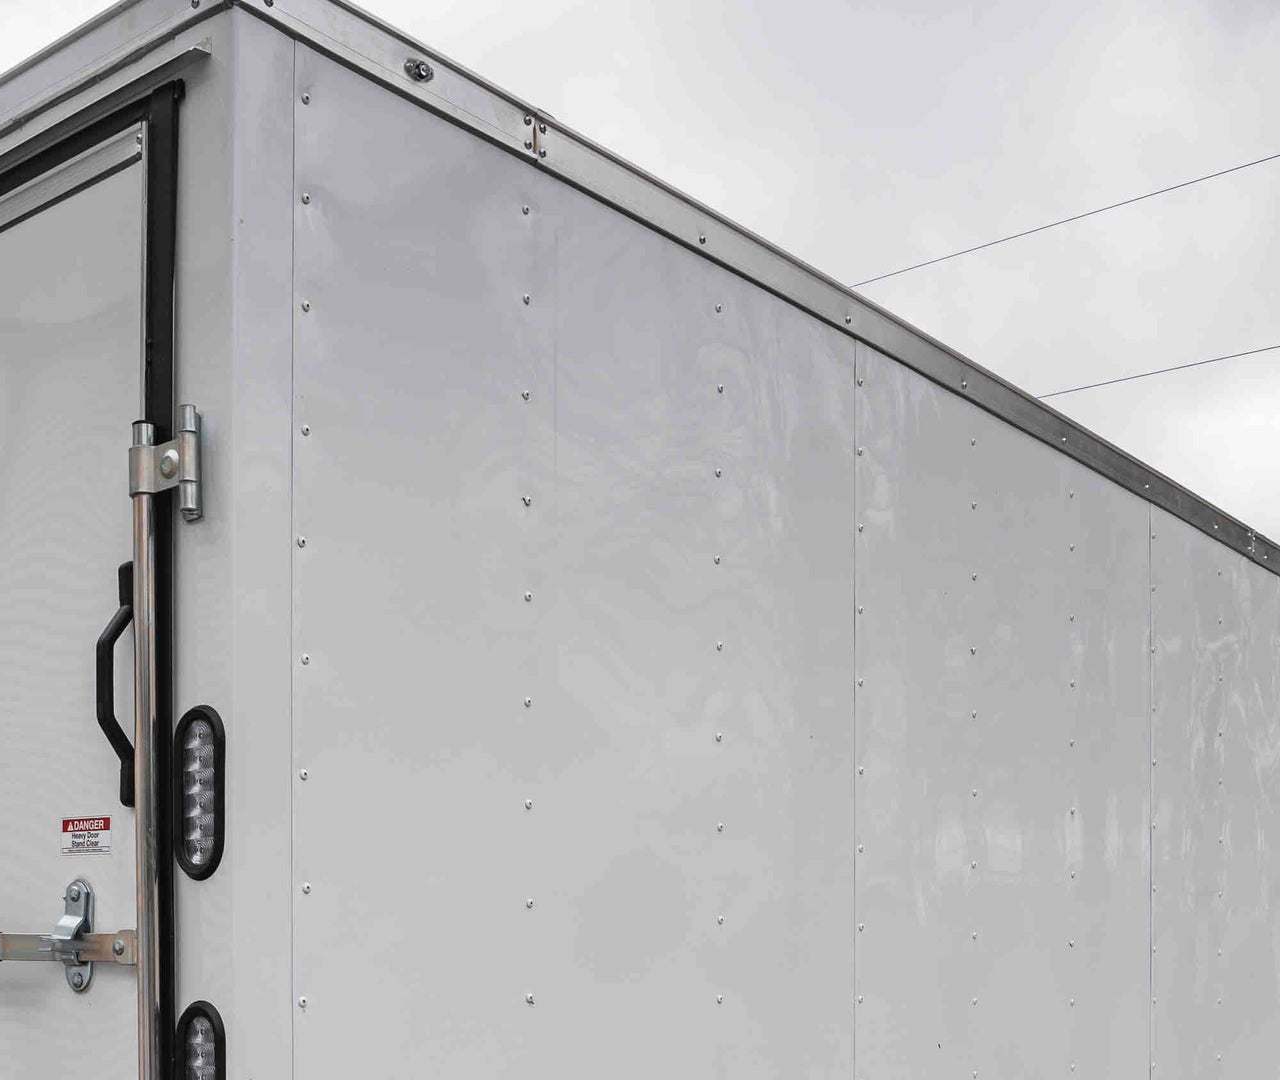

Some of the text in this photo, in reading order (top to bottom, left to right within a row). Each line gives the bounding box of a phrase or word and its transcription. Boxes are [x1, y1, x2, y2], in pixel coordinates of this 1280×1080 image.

[73, 819, 104, 831] DANGER
[71, 839, 100, 848] Stand Clear
